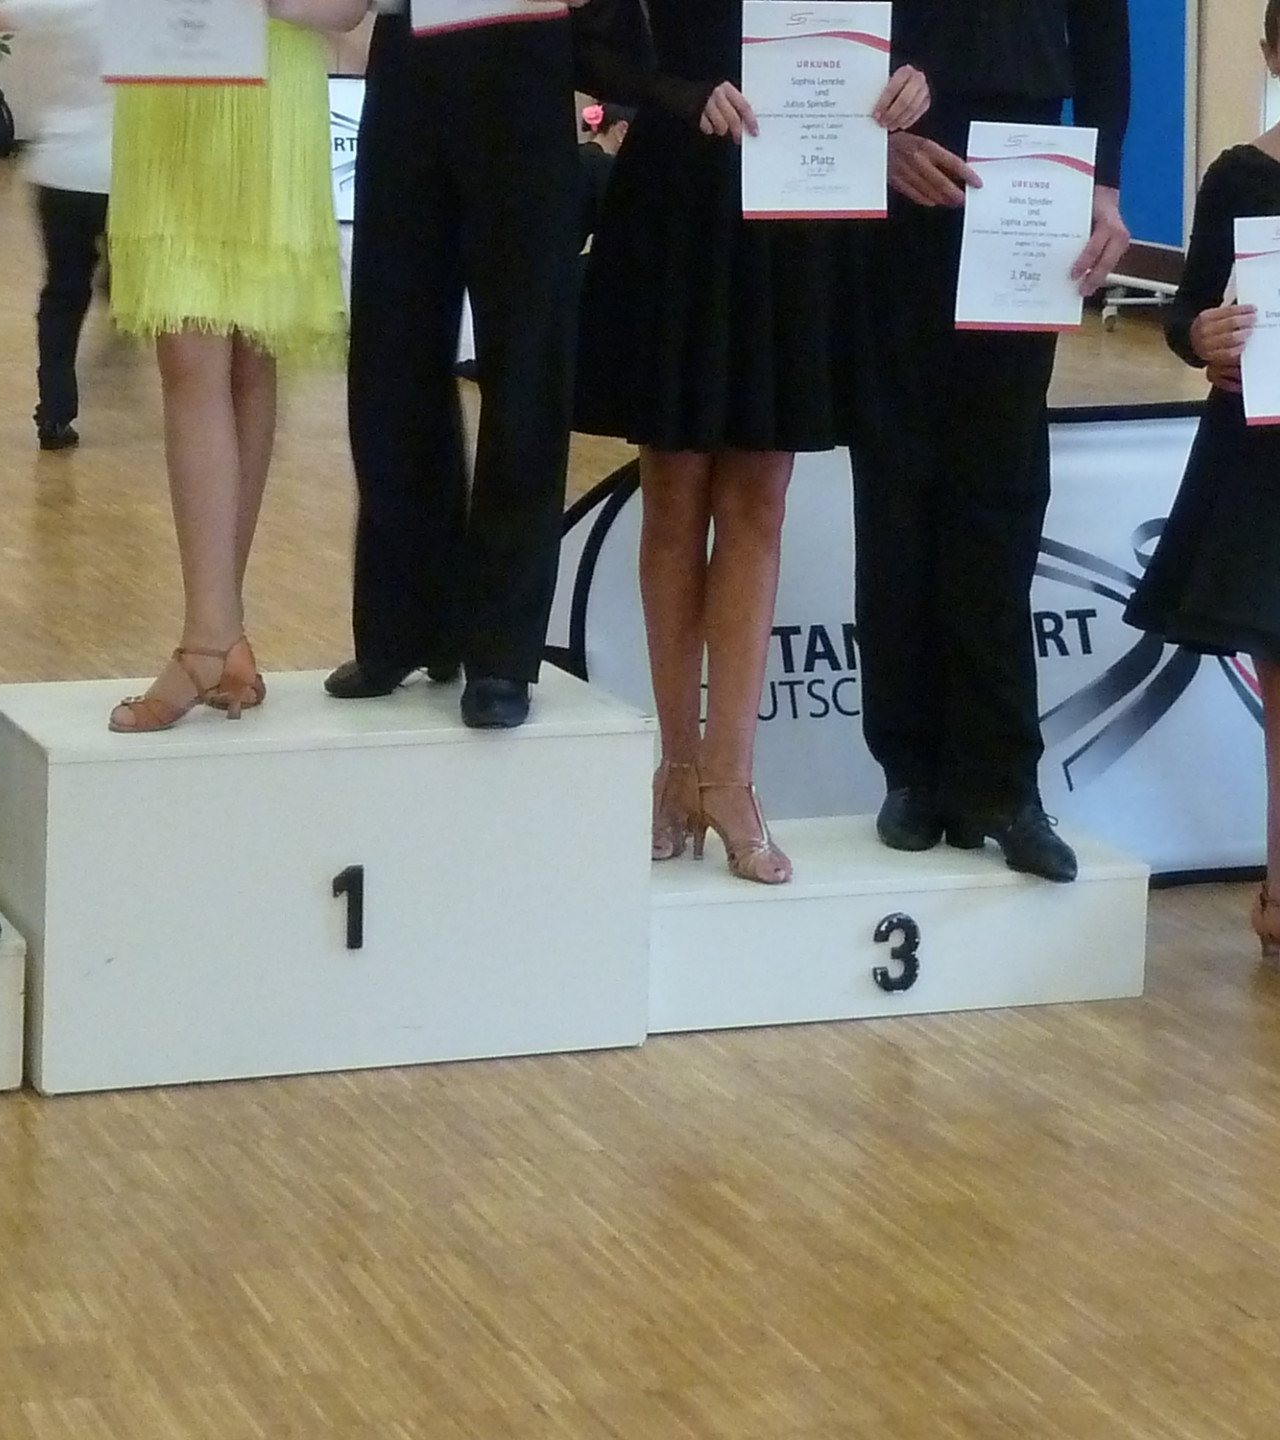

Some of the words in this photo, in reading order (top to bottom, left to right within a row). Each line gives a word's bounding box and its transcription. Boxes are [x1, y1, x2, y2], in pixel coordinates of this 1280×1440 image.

[796, 60, 841, 69] URKUNDE
[791, 77, 816, 86] Sophia
[814, 88, 830, 96] und
[800, 155, 810, 166] 3.
[810, 154, 835, 165] Platz
[1028, 208, 1040, 216] und
[1020, 270, 1041, 281] Platz
[332, 865, 363, 949] 1
[873, 912, 920, 991] 3
